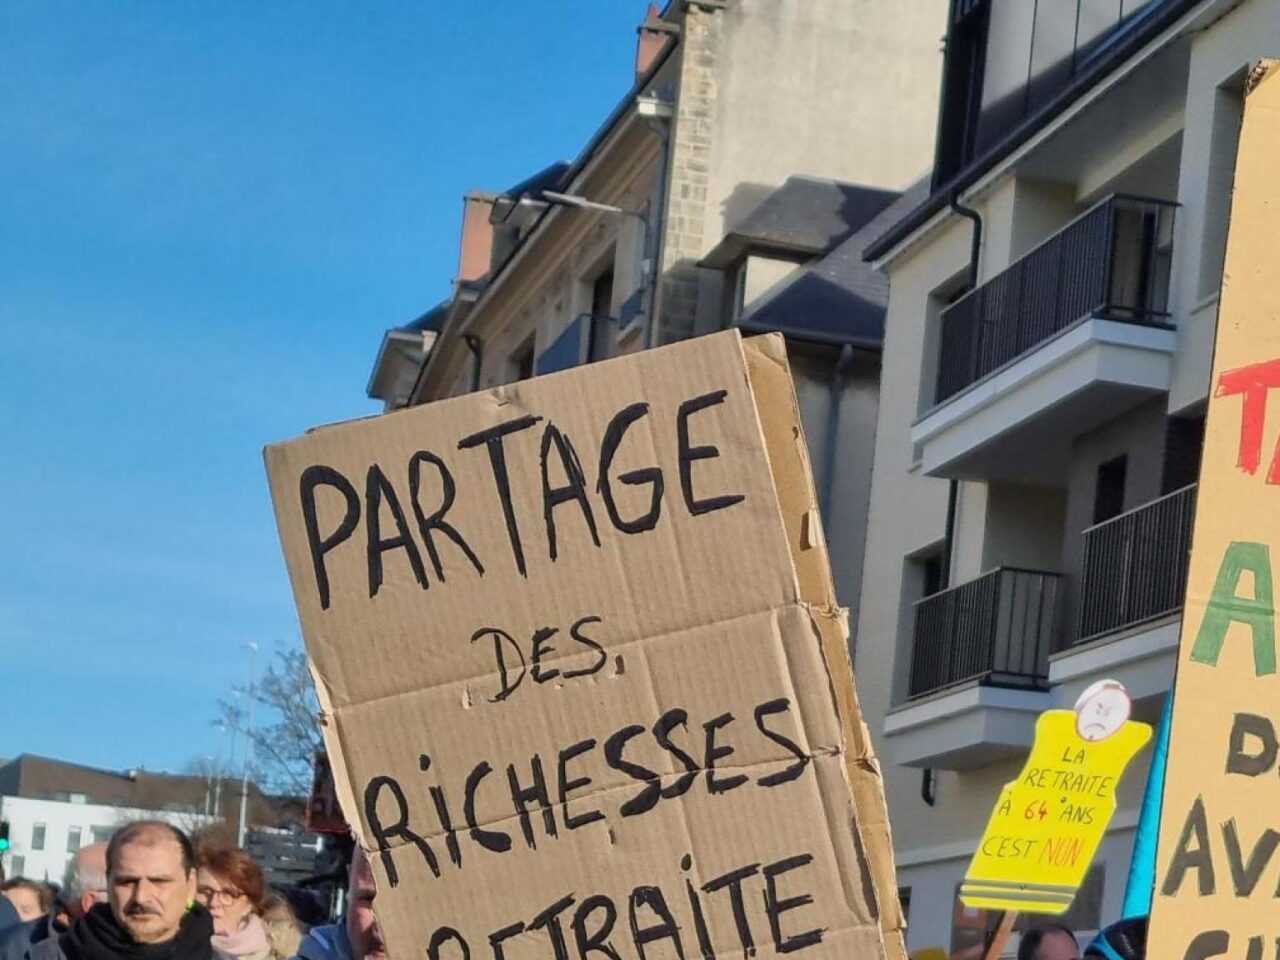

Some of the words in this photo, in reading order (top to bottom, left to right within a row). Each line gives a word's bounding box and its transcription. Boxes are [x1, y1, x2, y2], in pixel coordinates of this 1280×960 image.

[299, 389, 745, 610] PARTAGE
[470, 615, 608, 702] DES
[1062, 747, 1085, 764] LA
[1025, 769, 1112, 797] RETRAITE
[1025, 800, 1047, 820] 64
[1061, 804, 1094, 824] ANS
[982, 835, 1037, 858] C'EST
[1041, 838, 1084, 867] NON
